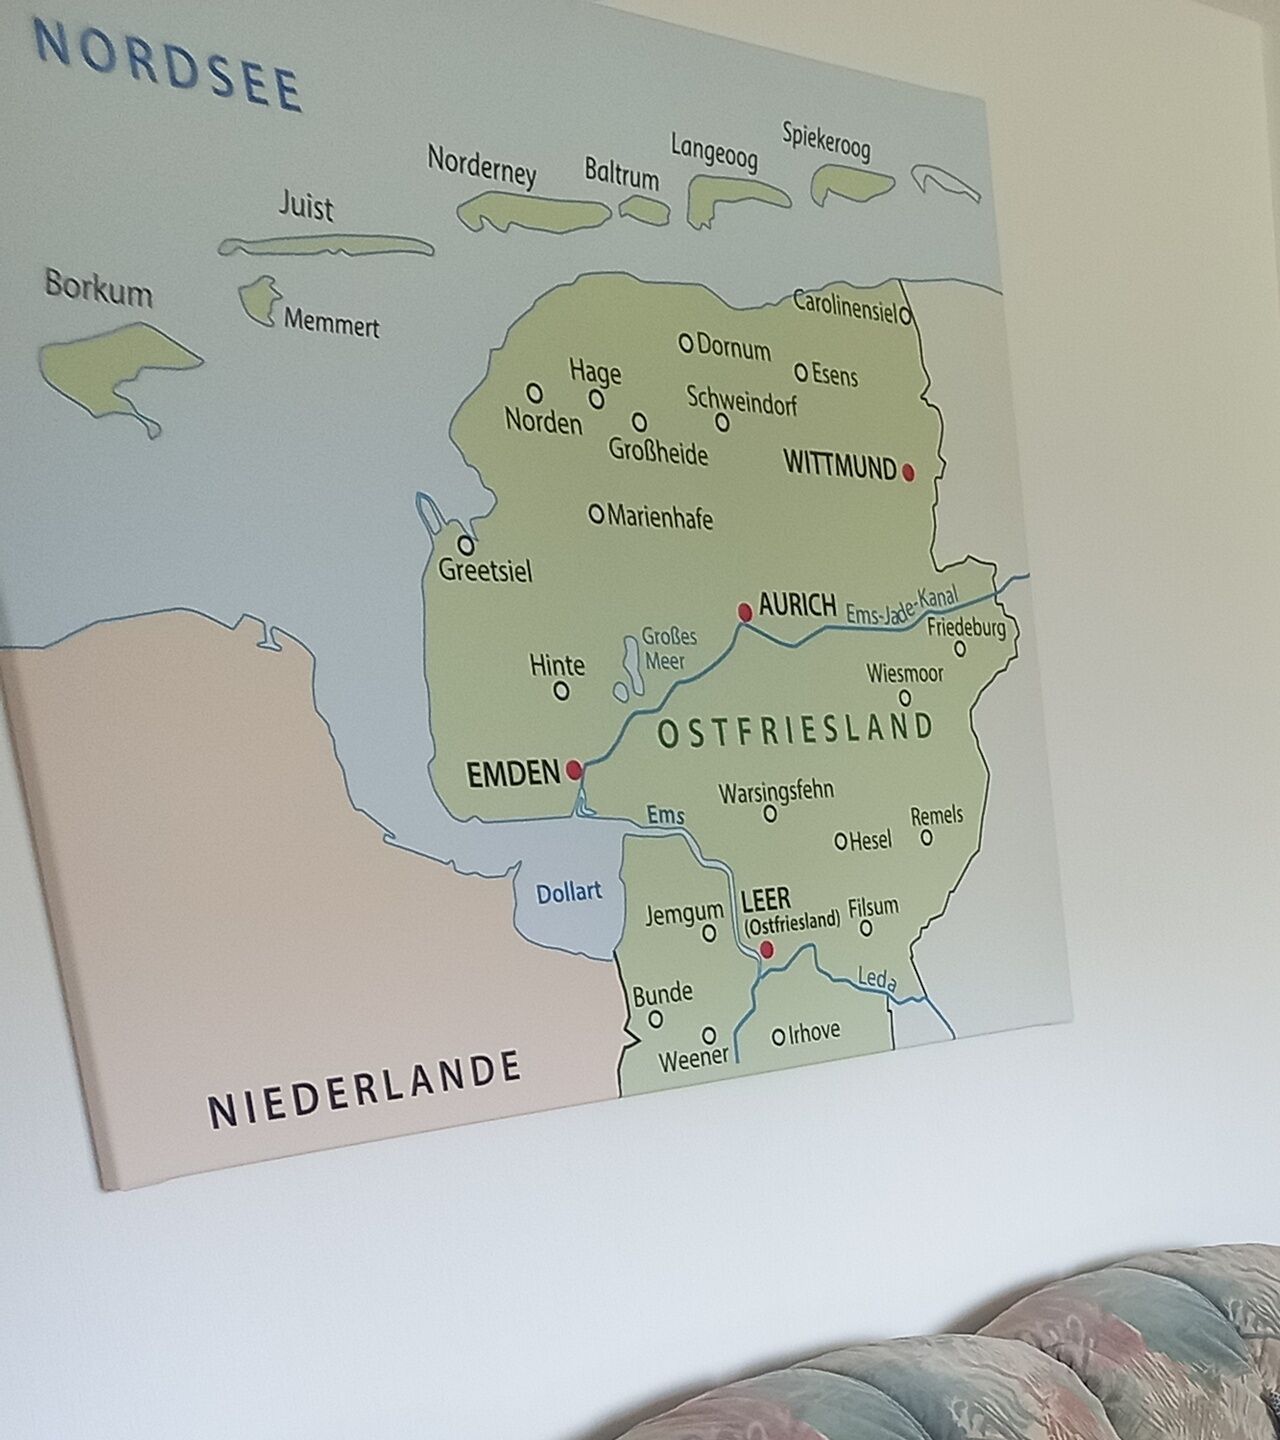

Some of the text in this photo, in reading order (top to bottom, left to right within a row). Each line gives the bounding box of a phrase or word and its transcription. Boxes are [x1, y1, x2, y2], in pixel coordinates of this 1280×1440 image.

[33, 16, 303, 113] NORDSEE
[672, 132, 758, 175] Langeoog
[783, 121, 871, 164] Spiekeroog
[428, 143, 536, 192] Norderney
[585, 156, 659, 191] Baltrum
[279, 189, 334, 222] Juist
[45, 268, 152, 308] Borkum
[794, 289, 898, 324] Carolinensiel
[285, 307, 380, 339] Memmert
[697, 332, 771, 361] Dornum
[569, 357, 622, 389] Hage
[812, 362, 858, 388] Esens
[687, 385, 797, 416] Schweindorf
[506, 406, 583, 435] Norden
[609, 437, 708, 466] Großheide
[784, 448, 897, 481] WITTMUND
[607, 503, 713, 530] Marienhafe
[439, 558, 533, 582] Greetsiel
[759, 592, 837, 616] AURICH
[846, 583, 958, 625] Ems-Jade-Kanal
[642, 627, 697, 646] Großes
[928, 616, 1006, 640] Friedeburg
[530, 654, 585, 676] Hinte
[646, 652, 685, 670] Meer
[867, 663, 944, 683] Wiesmoor
[658, 712, 932, 748] OSTFRIESLAND
[467, 759, 561, 788] EMDEN
[719, 778, 834, 805] Warsingsfehn
[647, 805, 685, 824] Ems
[911, 804, 963, 826] Remels
[850, 829, 892, 850] Hesel
[537, 880, 602, 904] Dollart
[741, 887, 791, 913] LEER
[646, 902, 724, 927] Jemgum
[848, 898, 899, 918] Filsum
[745, 909, 840, 938] (Ostfriesland)
[859, 966, 897, 993] Leda
[634, 981, 693, 1007] Bunde
[789, 1021, 841, 1045] Irhove
[659, 1047, 728, 1072] Weener
[208, 1050, 521, 1129] NIEDERLANDE
